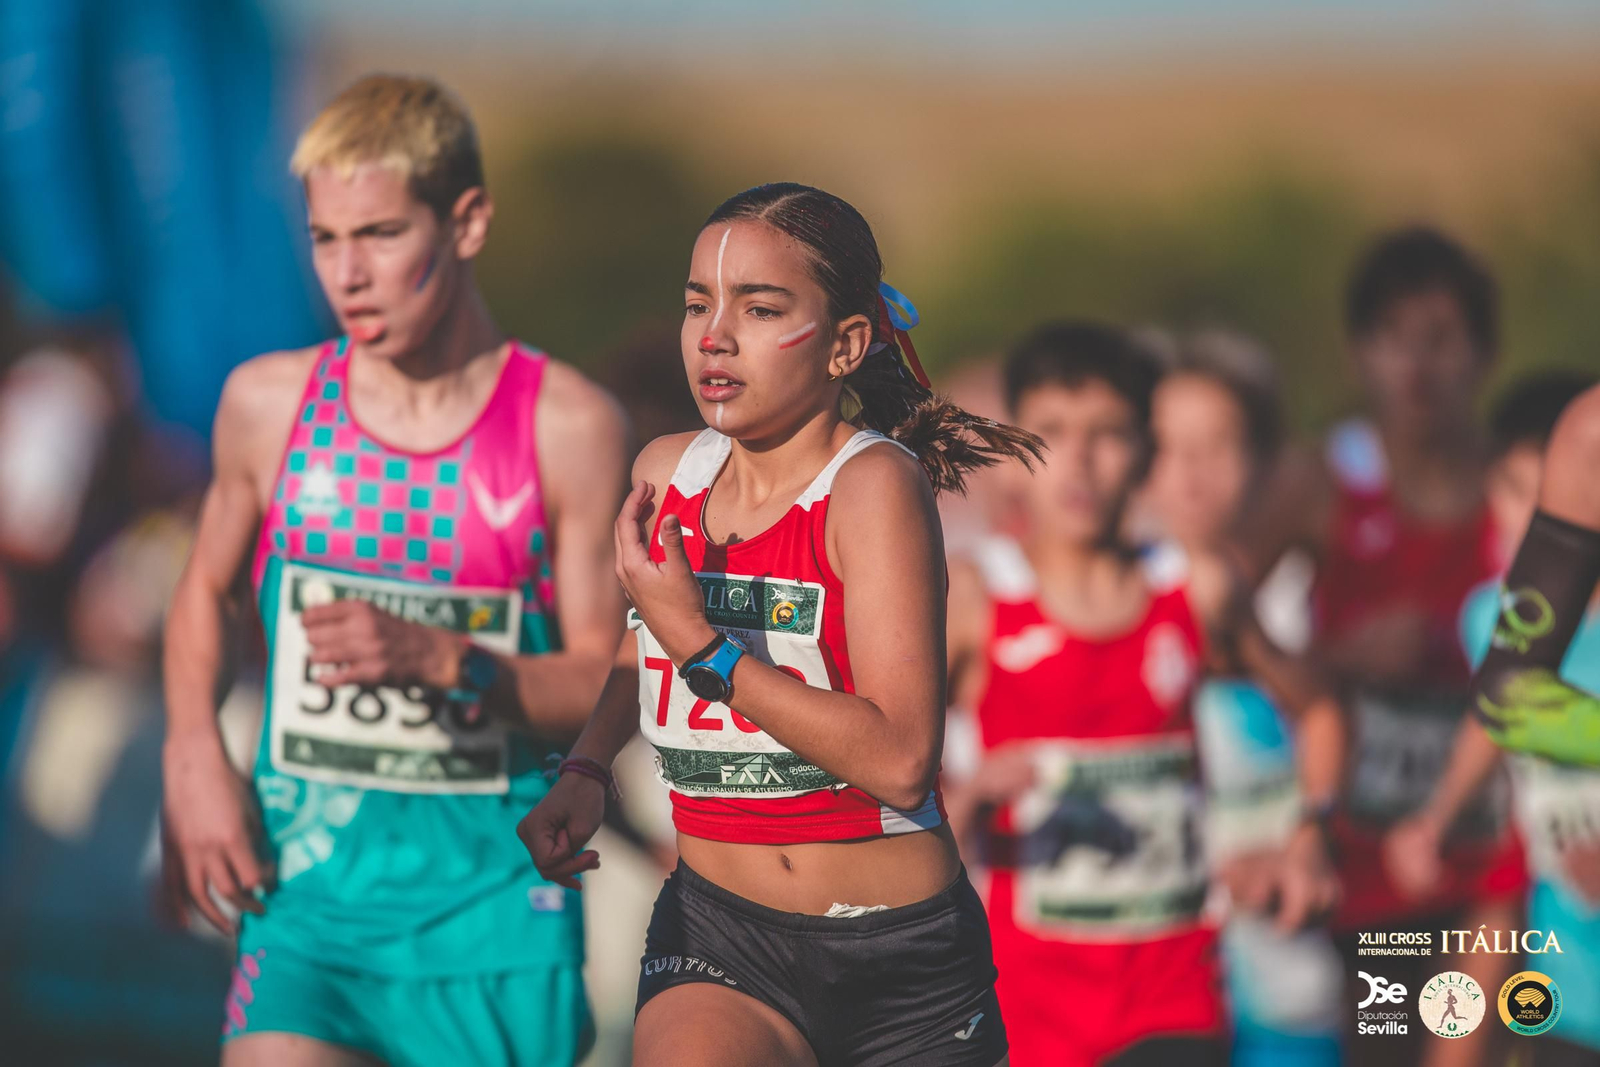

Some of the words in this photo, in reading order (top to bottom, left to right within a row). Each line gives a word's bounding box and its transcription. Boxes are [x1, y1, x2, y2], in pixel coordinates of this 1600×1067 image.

[700, 579, 758, 612] LICA
[798, 764, 819, 772] docu
[755, 786, 793, 794] ATLETISMO
